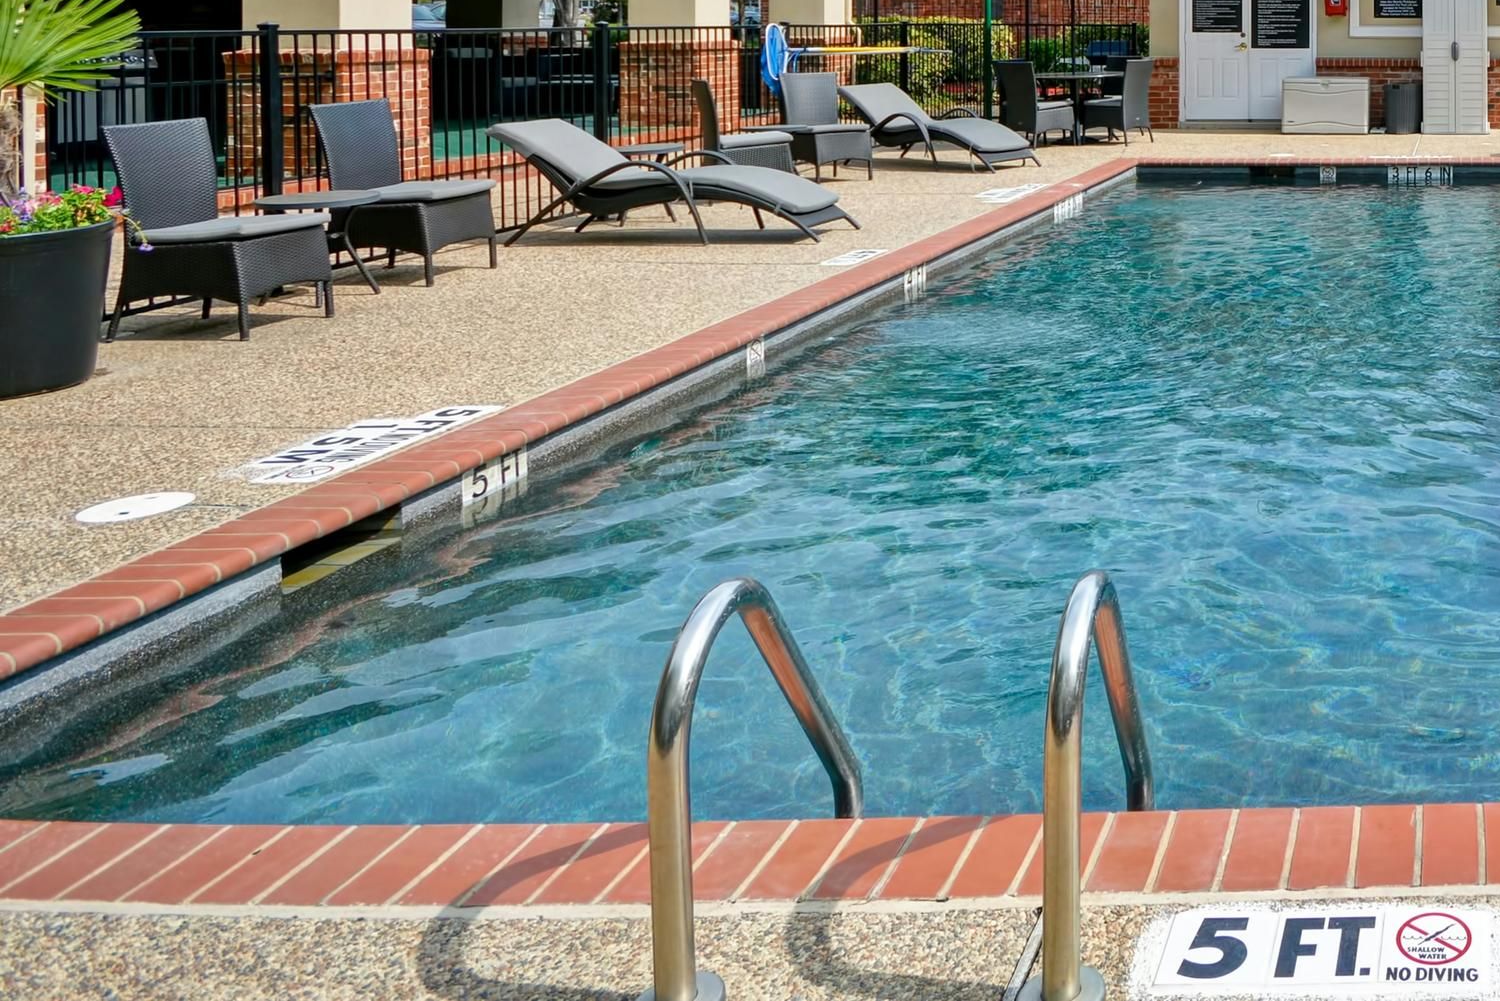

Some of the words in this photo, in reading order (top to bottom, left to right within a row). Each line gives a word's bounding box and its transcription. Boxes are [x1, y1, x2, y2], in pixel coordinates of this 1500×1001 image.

[1392, 167, 1399, 178] 3
[1425, 167, 1432, 178] 6
[434, 409, 481, 417] 5
[472, 463, 488, 498] 5
[501, 448, 522, 485] FT
[1177, 916, 1250, 979] 5
[1274, 916, 1377, 978] FT.
[1386, 966, 1411, 981] NO
[1415, 967, 1479, 982] DIVING
